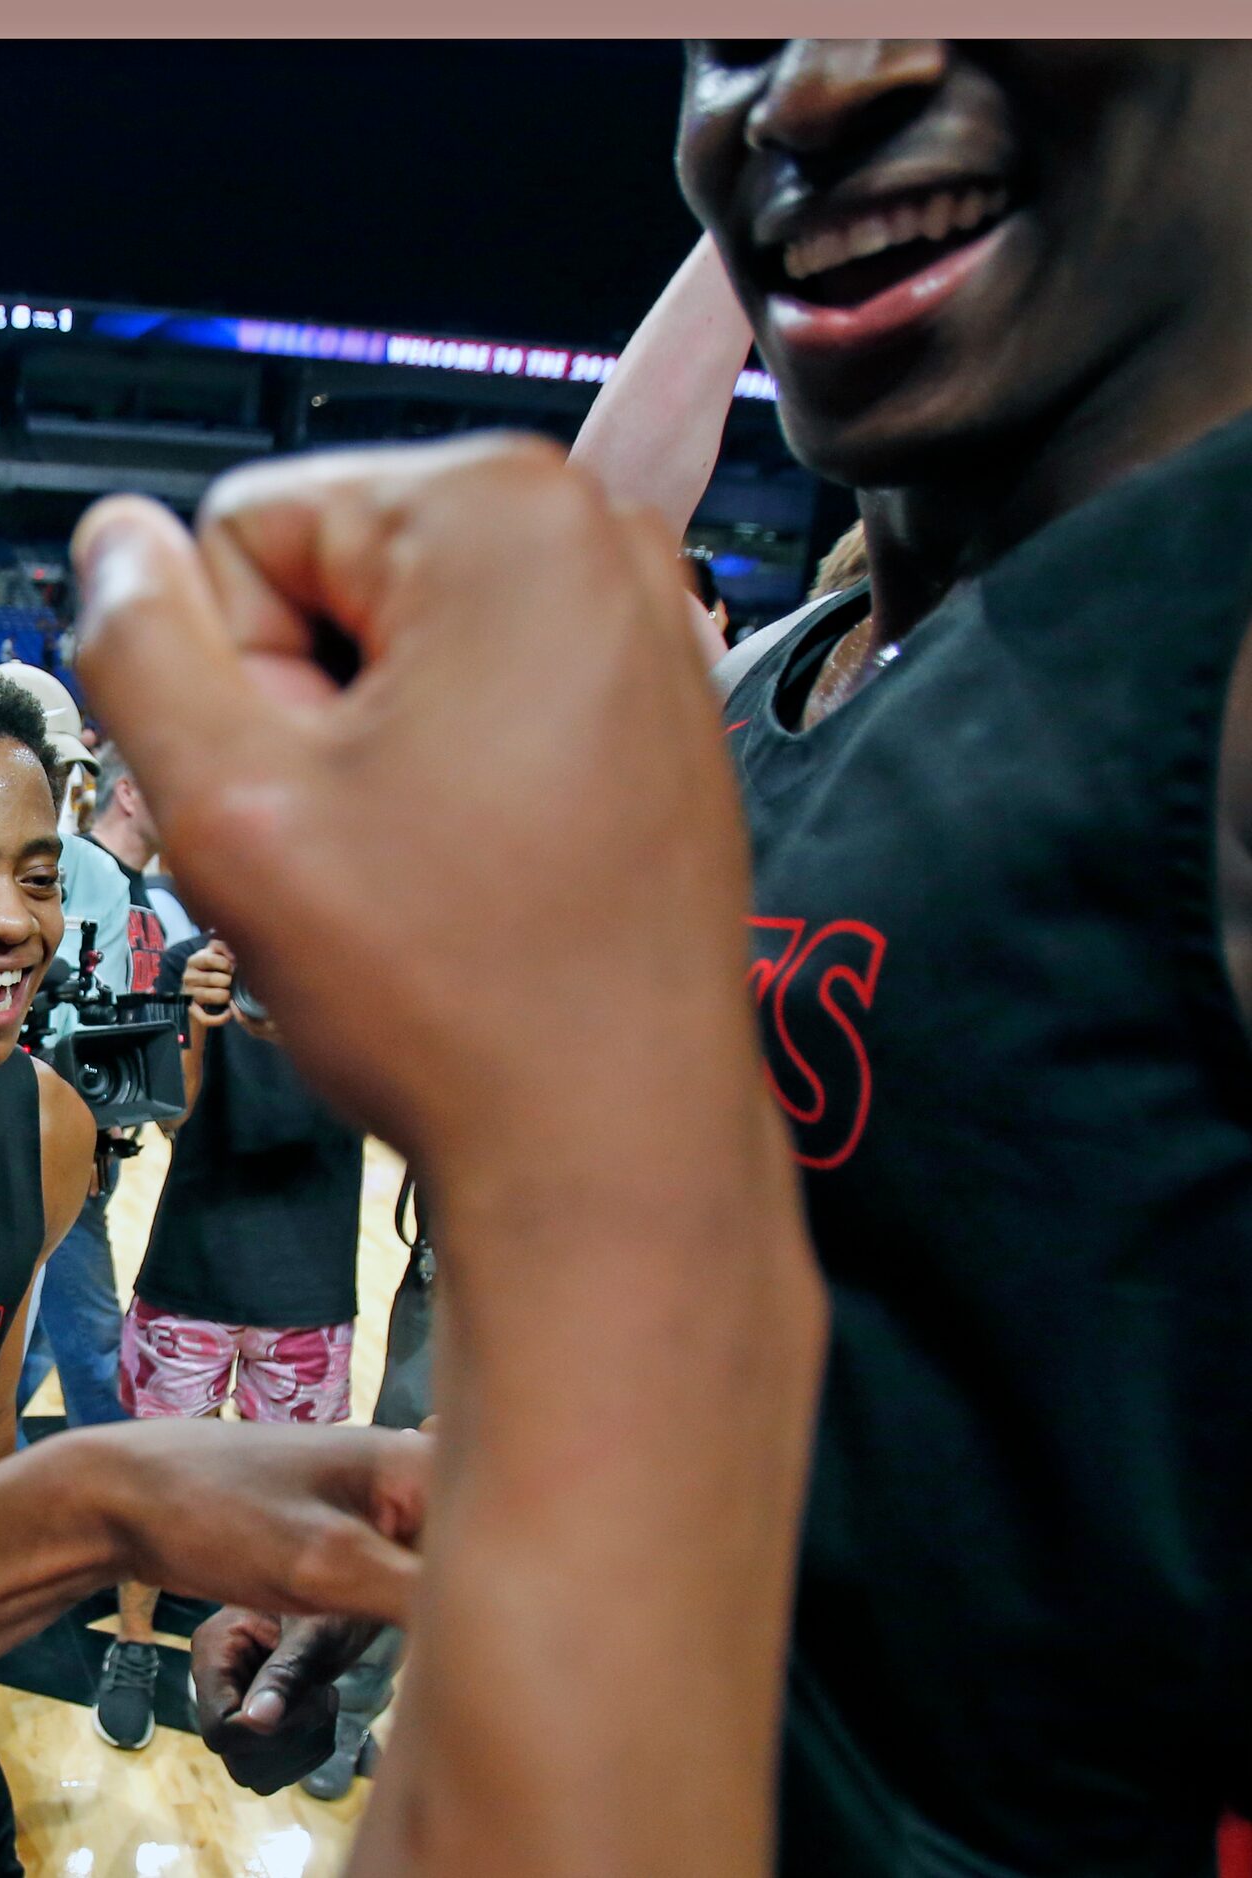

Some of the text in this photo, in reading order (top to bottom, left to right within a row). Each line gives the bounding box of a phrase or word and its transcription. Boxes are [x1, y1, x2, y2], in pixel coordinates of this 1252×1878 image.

[386, 336, 491, 373] WELCOME
[491, 346, 524, 375] TO
[525, 349, 569, 380] THE
